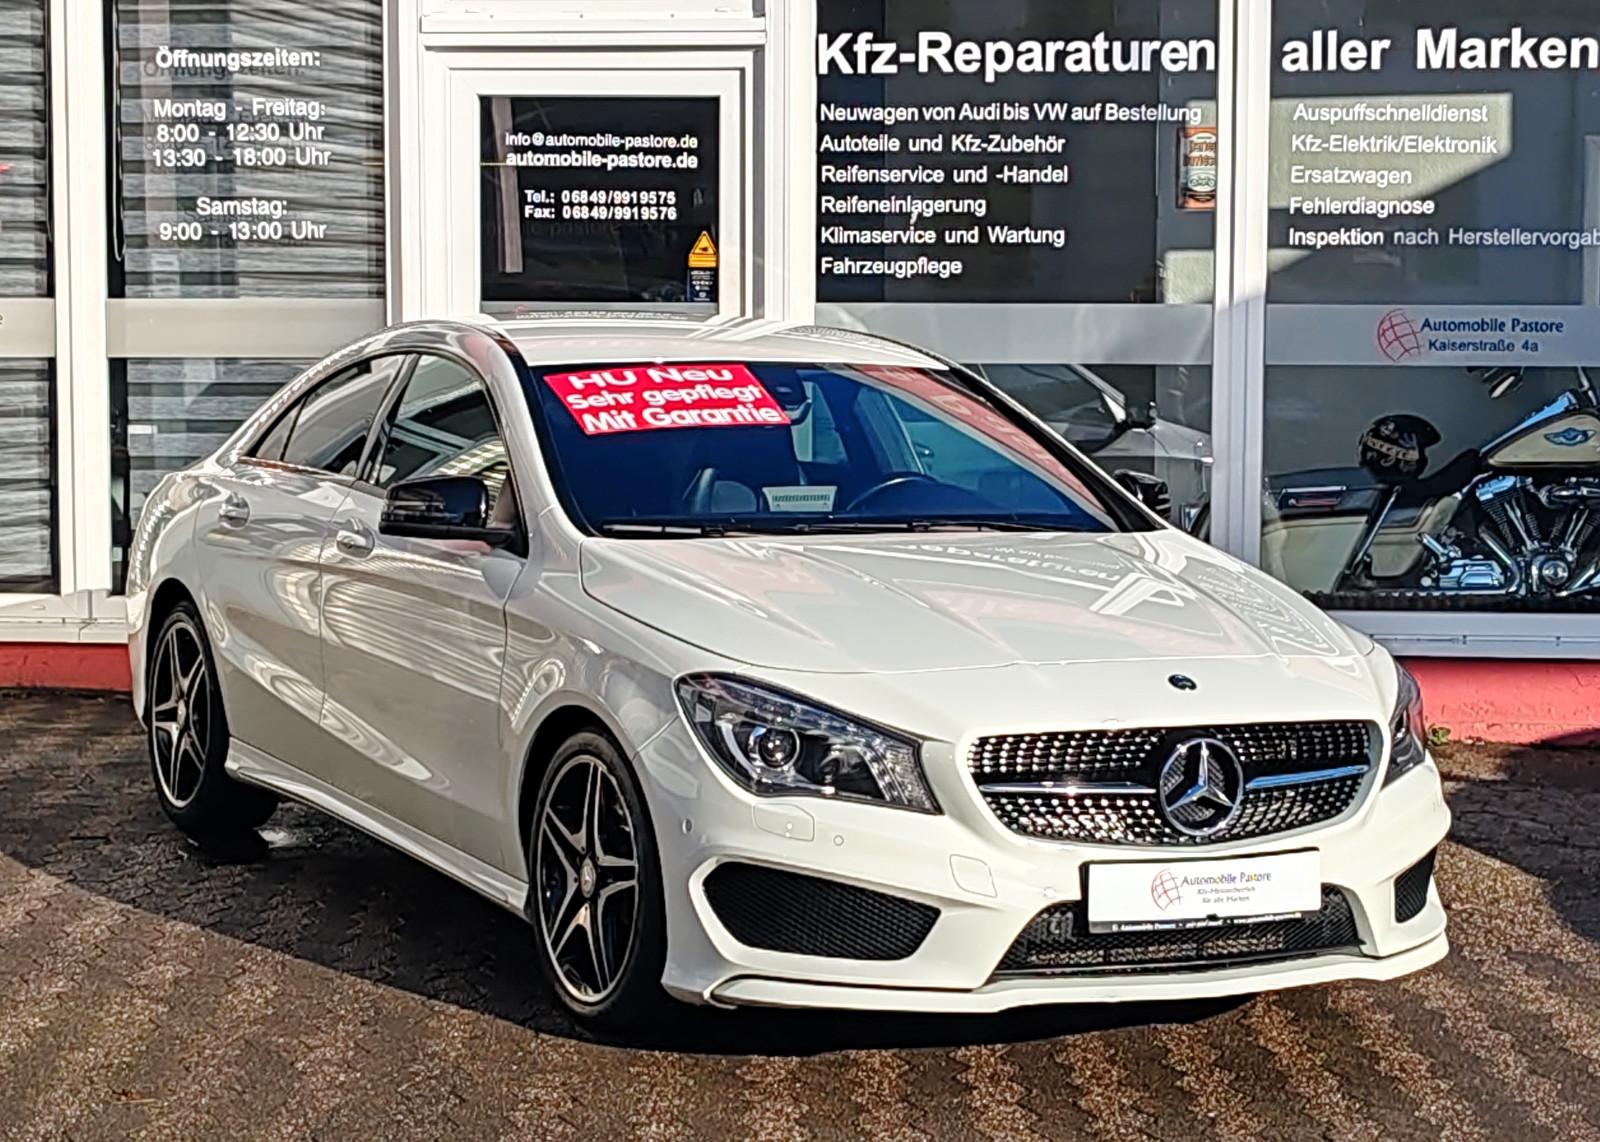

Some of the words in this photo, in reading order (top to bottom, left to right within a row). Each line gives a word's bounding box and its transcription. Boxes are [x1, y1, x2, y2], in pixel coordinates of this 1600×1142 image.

[155, 46, 320, 71] Öffnungszeiten:
[817, 31, 1216, 83] Kfz-Reparaturen
[1281, 29, 1391, 71] aller
[1416, 27, 1600, 70] Marken
[154, 100, 226, 120] Montag
[252, 99, 325, 119] Freitag:
[820, 103, 918, 124] Neuwagen
[923, 107, 955, 121] von
[959, 103, 1000, 121] Audi
[1003, 103, 1030, 121] bis
[1034, 103, 1067, 121] VW
[1071, 103, 1102, 121] auf
[1105, 103, 1202, 125] Bestellung
[1293, 104, 1488, 124] Auspuffschnelldienst
[156, 124, 200, 142] 8:00
[227, 124, 280, 141] 12:30
[290, 123, 325, 141] Uhr
[820, 134, 900, 152] Autoteile
[908, 134, 942, 152] und
[951, 134, 1066, 152] Kfz-Zubehör
[1291, 135, 1497, 154] Kfz-Elektrik/Elektronik
[153, 149, 206, 167] 13:30
[233, 149, 286, 166] 18:00
[296, 148, 331, 166] Uhr
[505, 151, 698, 170] automobile-pastore.de
[820, 165, 945, 183] Reifenservice
[953, 165, 987, 183] und
[996, 165, 1069, 183] -Handel
[1290, 166, 1413, 187] Ersatzwagen
[524, 189, 555, 204] Tel.:
[561, 190, 676, 205] 06849/9919575
[820, 196, 987, 217] Reifeneinlagerung
[1289, 197, 1435, 218] Fehlerdiagnose
[196, 197, 288, 219] Samstag:
[524, 205, 555, 219] Fax:
[562, 205, 677, 220] 06849/9919576
[159, 223, 202, 240] 9:00
[229, 223, 282, 240] 13:00
[292, 222, 327, 240] Uhr
[820, 226, 937, 244] Klimaservice
[945, 226, 978, 244] und
[987, 226, 1065, 247] Wartung
[1289, 228, 1384, 249] Inspektion
[1393, 227, 1438, 245] nach
[820, 257, 963, 278] Fahrzeugpflege
[1420, 318, 1506, 333] Automobile
[1511, 318, 1564, 333] Pastore
[1428, 338, 1515, 352] Kaiserstraße
[1521, 339, 1539, 352] 4a
[567, 371, 638, 389] HU
[647, 368, 734, 384] Neu
[566, 390, 634, 410] Sehr
[641, 384, 763, 407] gepflegt
[581, 412, 636, 433] Mit
[641, 403, 781, 427] Garantie
[1180, 873, 1237, 887] Automobile
[1240, 871, 1272, 883] Pastore
